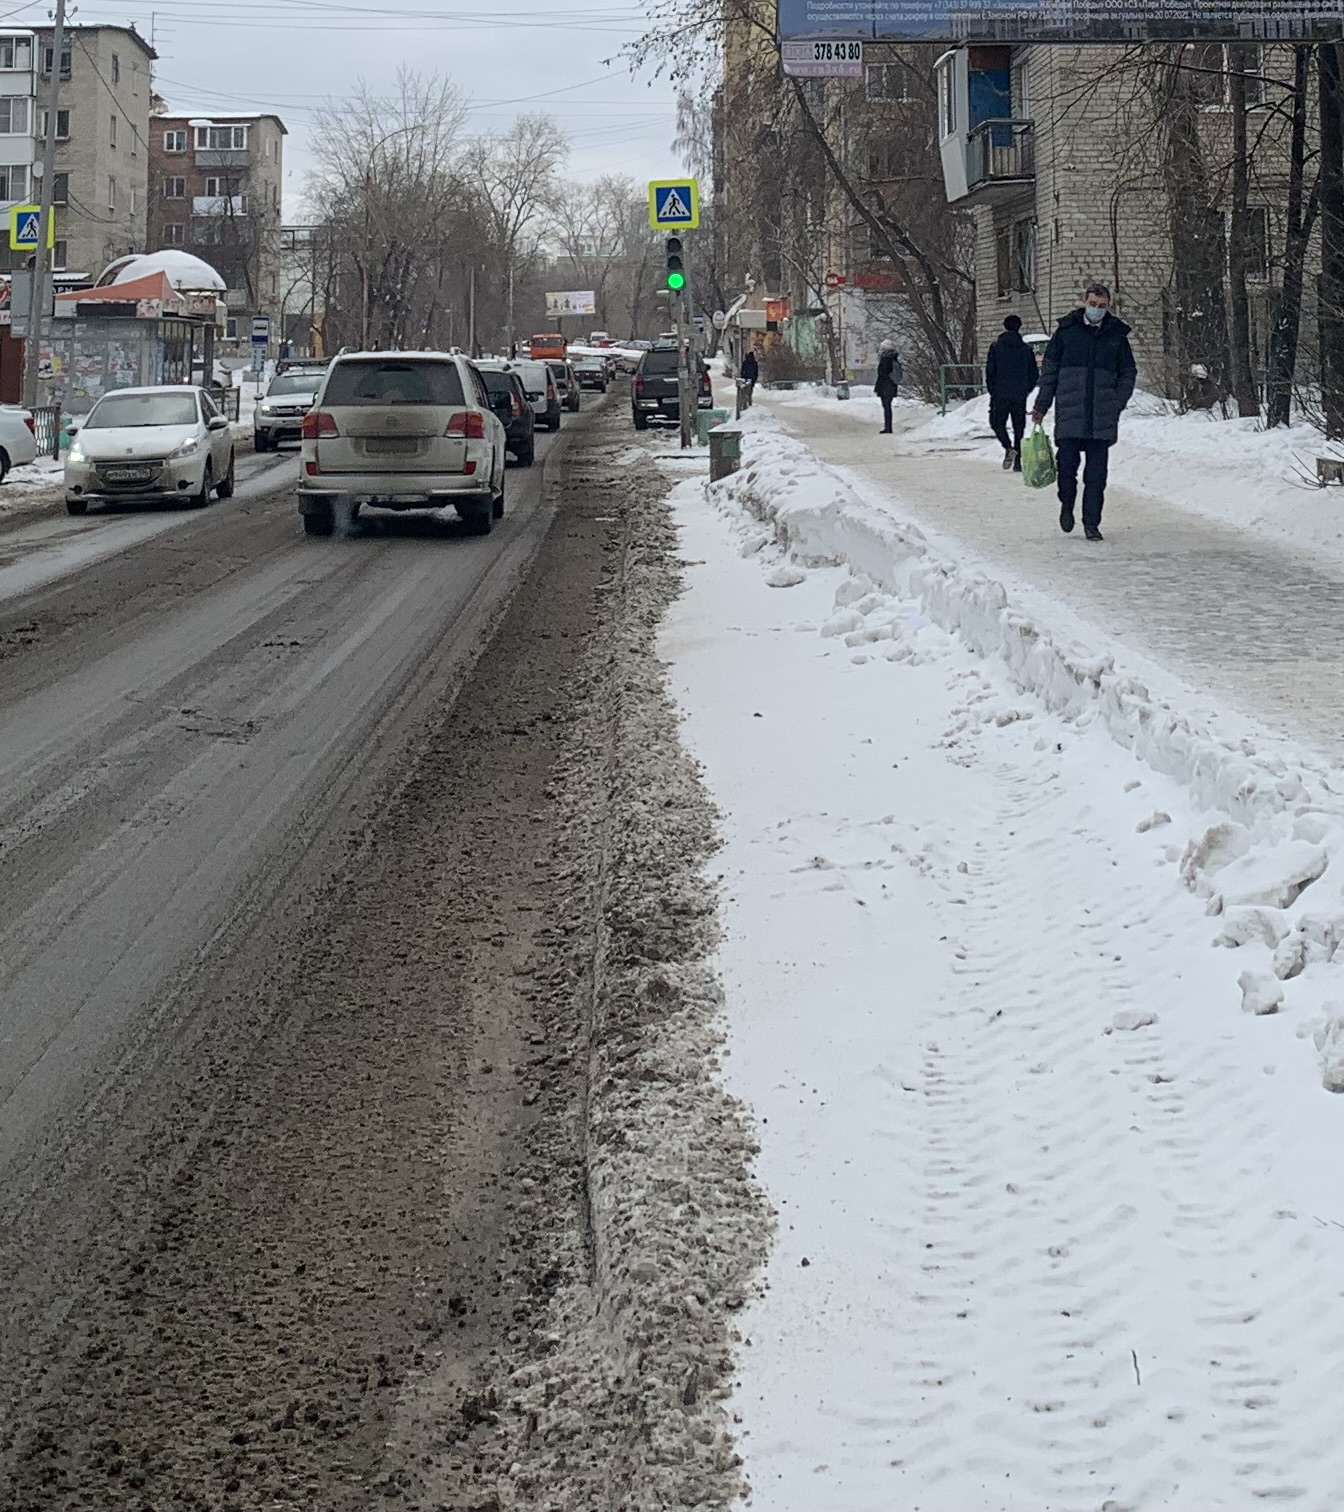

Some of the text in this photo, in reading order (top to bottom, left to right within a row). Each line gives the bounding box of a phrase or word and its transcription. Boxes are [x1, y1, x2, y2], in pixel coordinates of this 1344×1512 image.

[1106, 0, 1123, 10] ООО
[814, 42, 833, 61] 378
[834, 43, 846, 60] 43
[848, 42, 860, 60] 80
